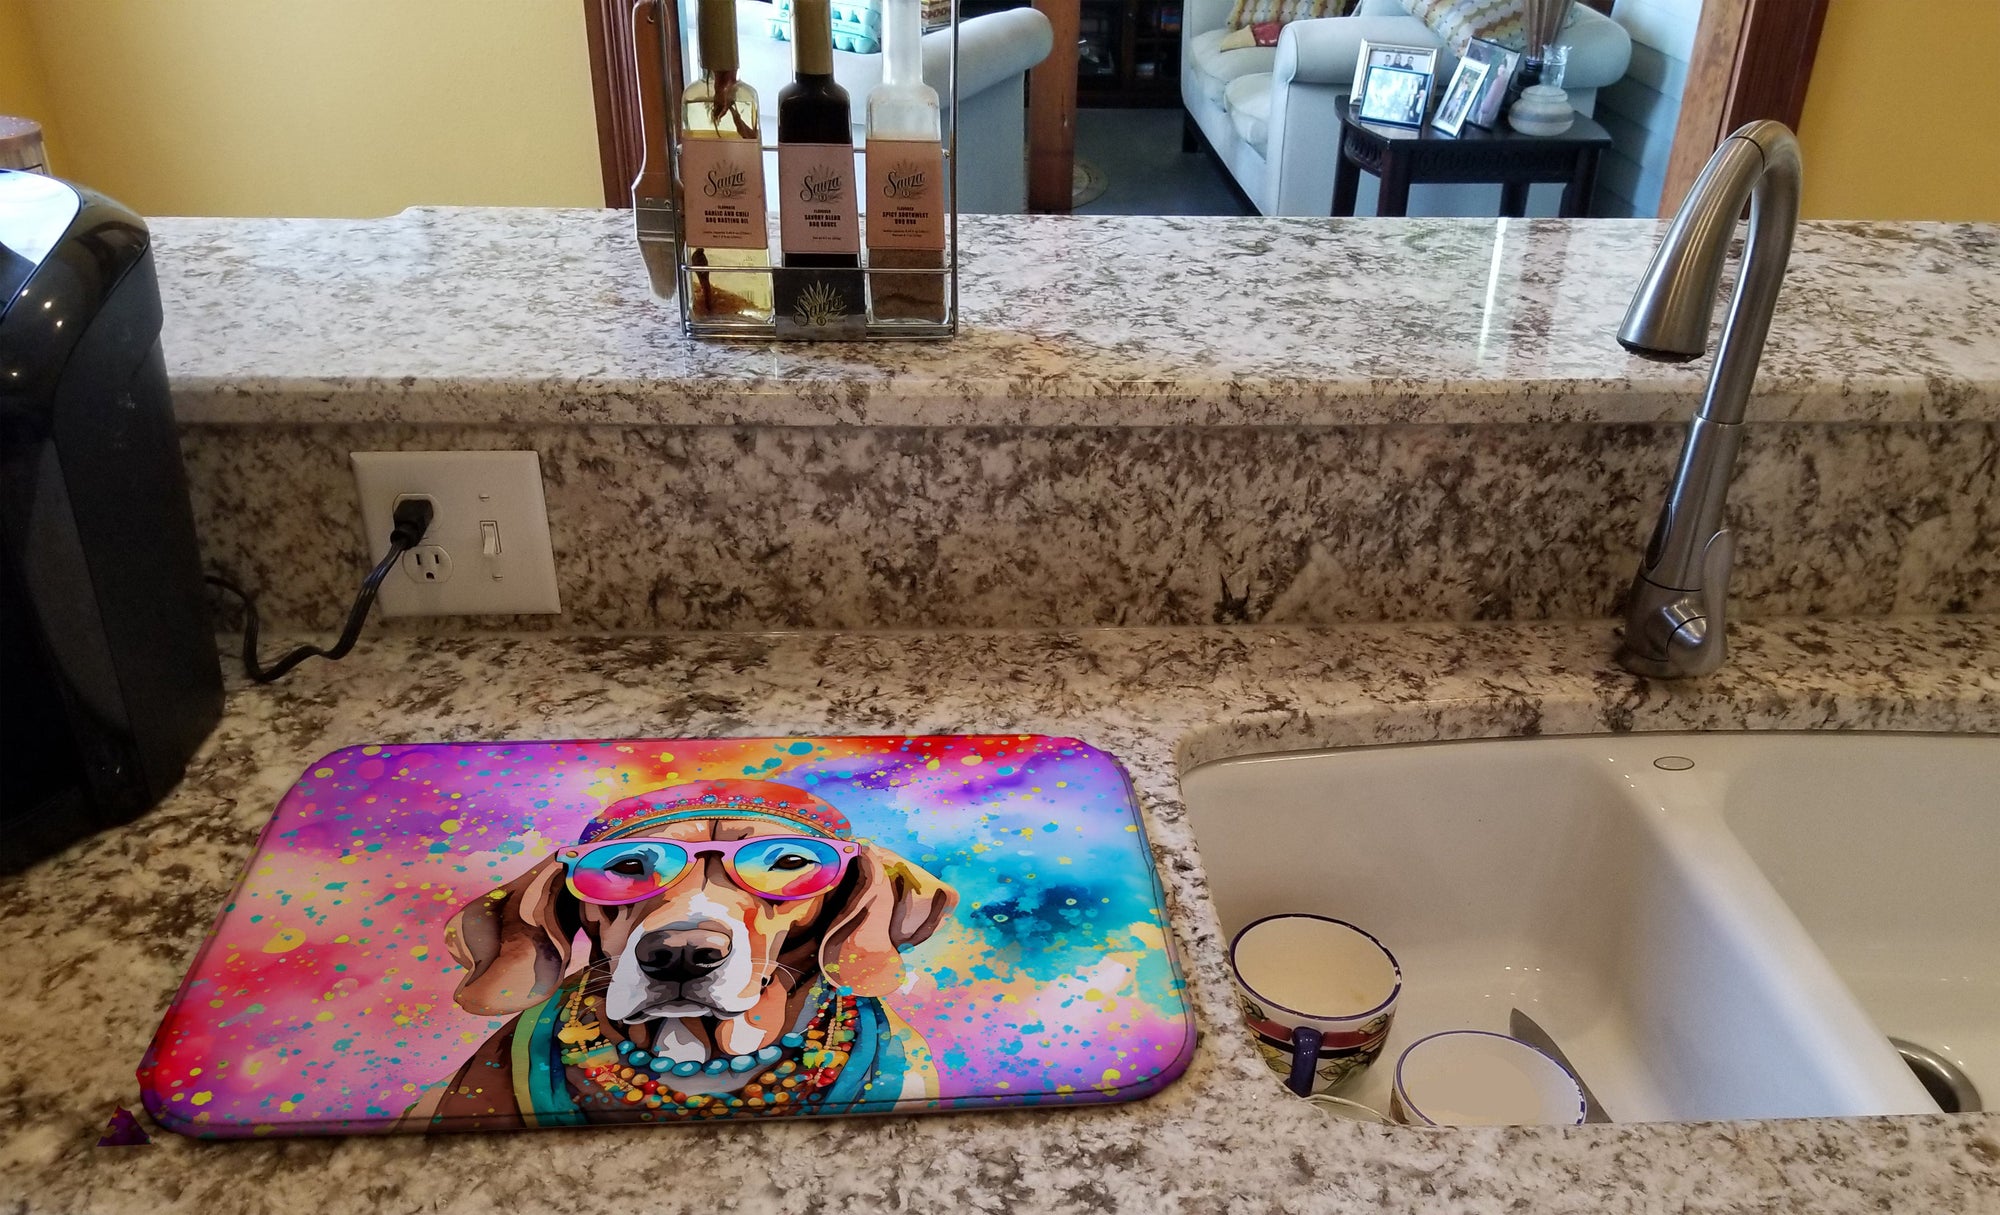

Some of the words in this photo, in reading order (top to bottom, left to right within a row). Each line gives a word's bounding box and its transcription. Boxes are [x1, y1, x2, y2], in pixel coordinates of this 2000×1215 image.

[704, 170, 745, 198] Sauza
[800, 175, 841, 202] Sauza
[883, 171, 925, 198] Sauza
